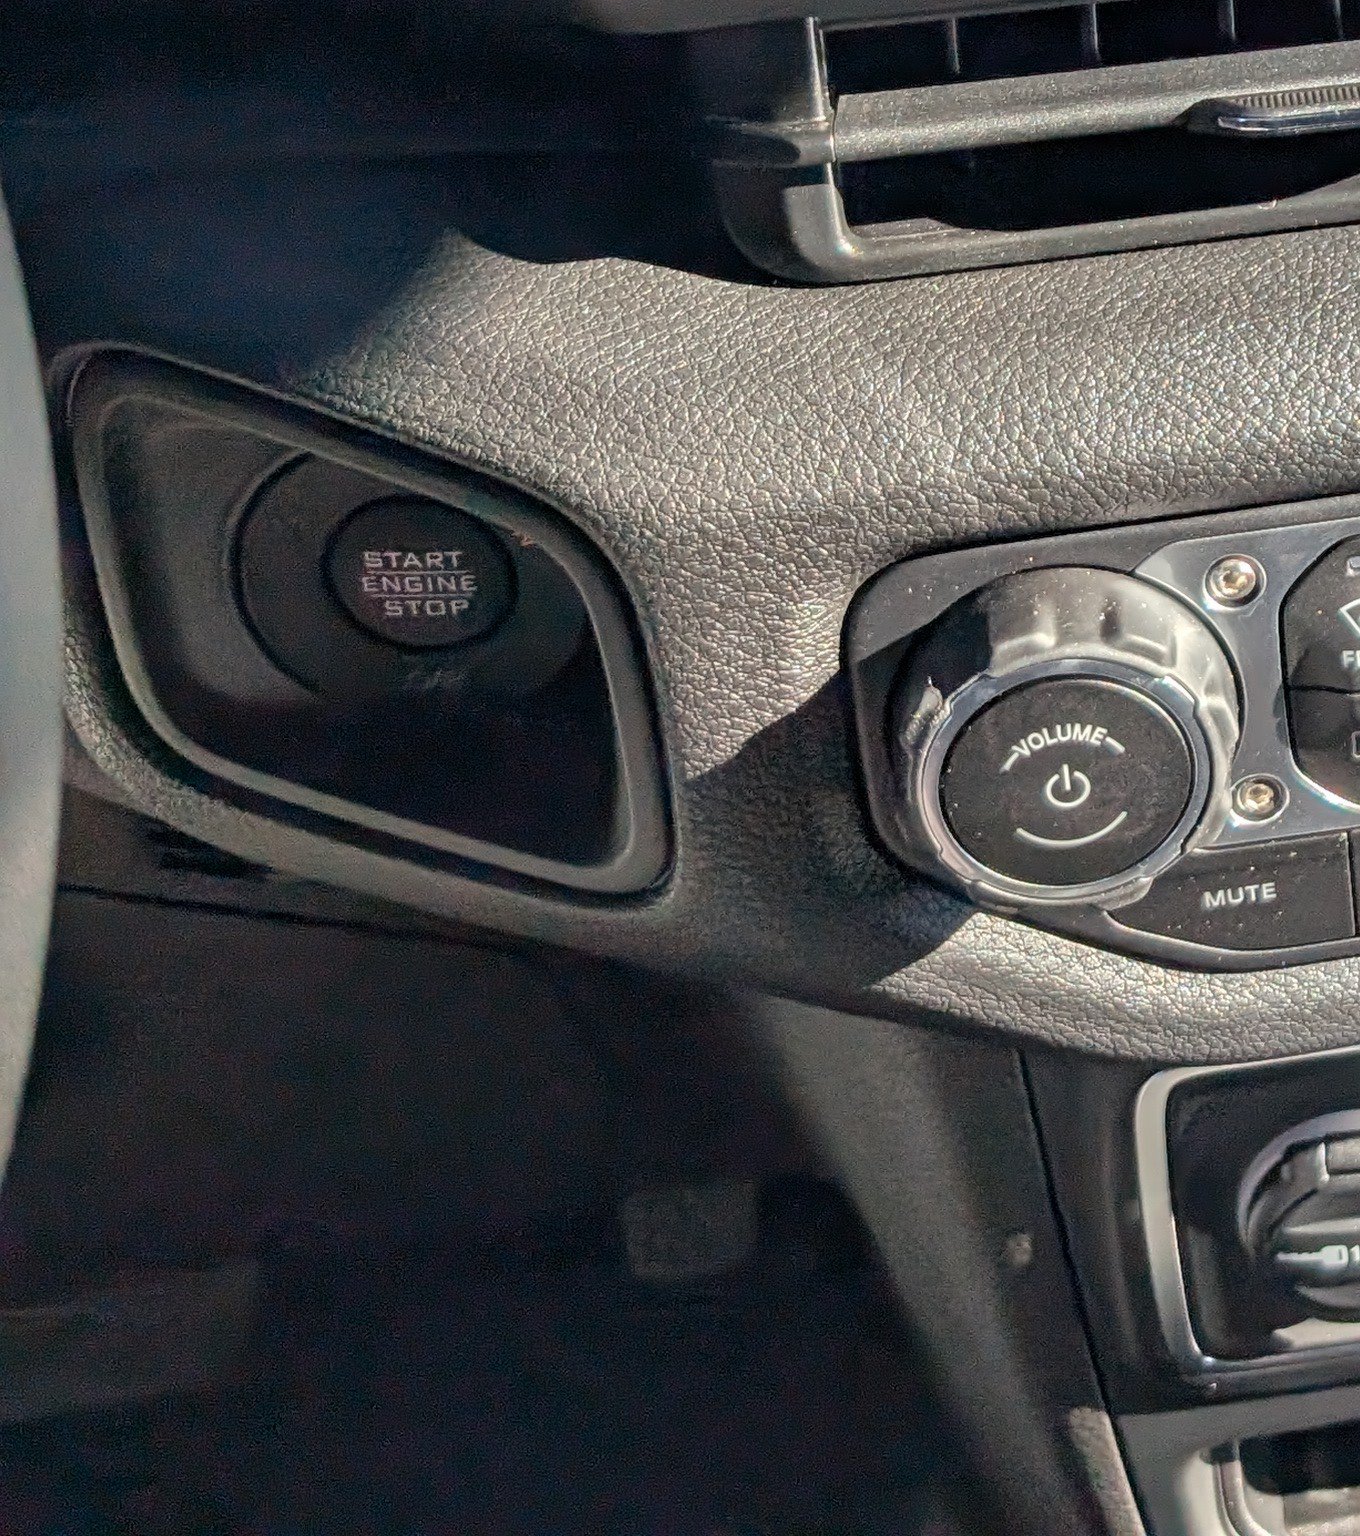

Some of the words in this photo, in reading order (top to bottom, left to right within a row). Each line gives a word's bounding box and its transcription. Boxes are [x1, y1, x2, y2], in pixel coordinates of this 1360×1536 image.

[362, 551, 463, 568] START
[361, 574, 478, 593] ENGINE
[384, 599, 470, 616] STOP
[1012, 723, 1109, 759] VOLUME
[1204, 882, 1278, 907] MUTE
